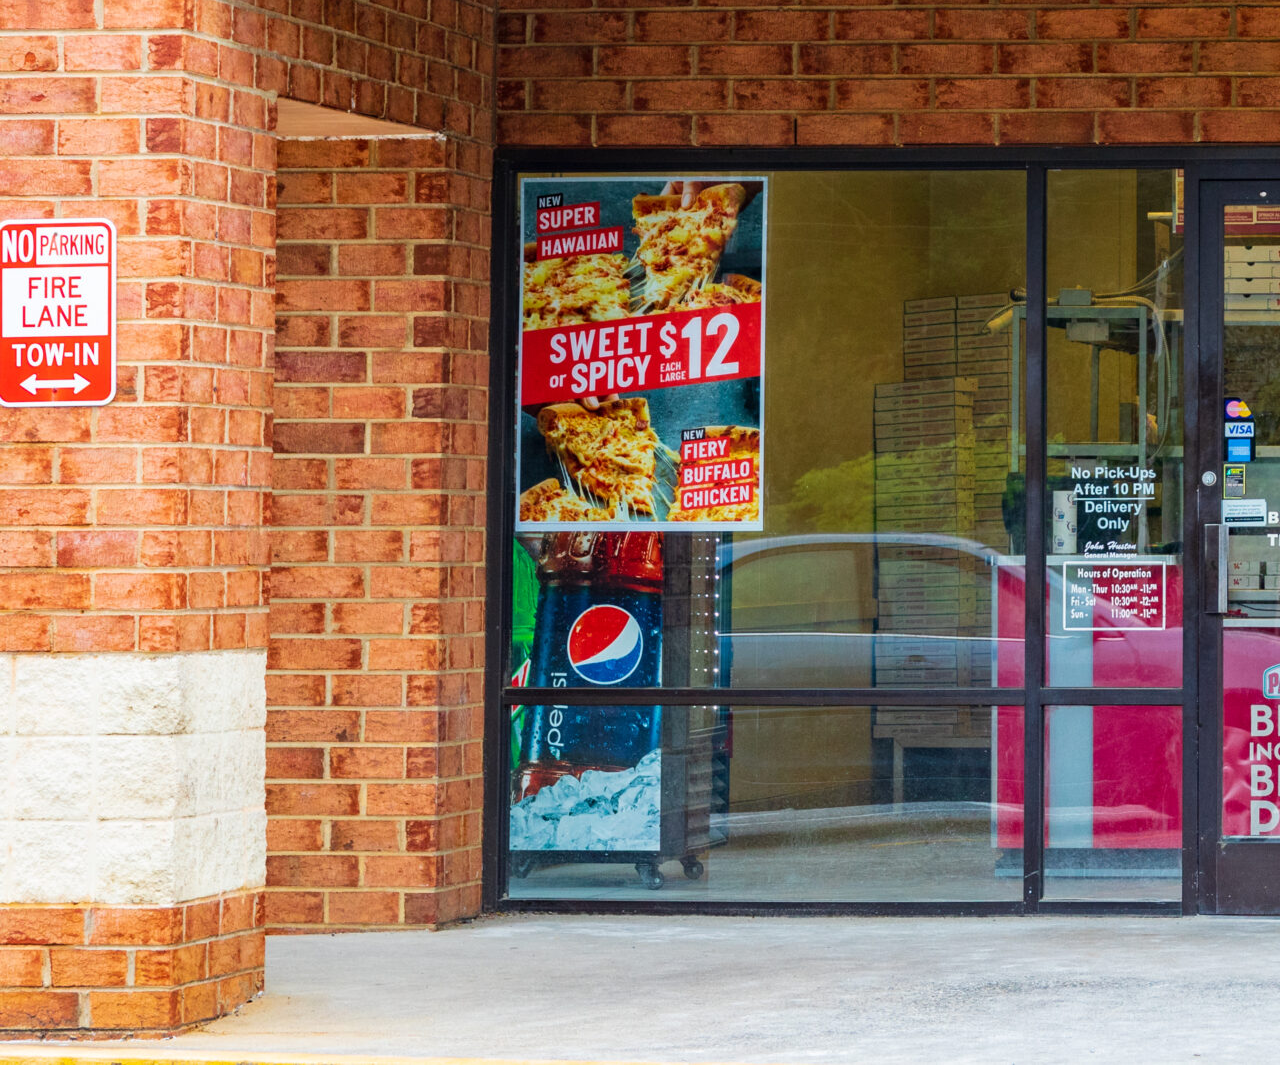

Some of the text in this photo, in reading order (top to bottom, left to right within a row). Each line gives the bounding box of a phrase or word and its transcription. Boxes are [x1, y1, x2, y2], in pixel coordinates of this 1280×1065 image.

[539, 195, 562, 208] NEW
[539, 207, 595, 230] SUPER
[2, 229, 105, 263] NO PARKING
[541, 231, 619, 256] HAWAIIAN
[28, 276, 82, 299] FIRE
[22, 305, 88, 328] LANE
[550, 322, 652, 364] SWEET
[11, 342, 99, 367] TOW-IN
[550, 354, 651, 394] or SPICY
[660, 361, 682, 373] EACH
[660, 371, 687, 382] LARGE
[684, 429, 704, 440] NEW
[1228, 425, 1252, 434] VISA
[684, 440, 728, 461] FIERY
[684, 462, 750, 484] BUFFALO
[1071, 467, 1156, 483] No Pick-Ups
[1073, 483, 1155, 495] After 10 PM
[684, 488, 750, 509] CHICKEN
[1085, 501, 1142, 516] Delivery
[1097, 517, 1130, 532] Only
[1084, 541, 1105, 552] John
[1078, 568, 1152, 580] Hours of Operation
[1071, 584, 1086, 594] Mon
[1092, 584, 1108, 594] Thur
[1071, 596, 1080, 606] Fri
[1085, 596, 1096, 606] Sat
[1071, 609, 1084, 618] Sun
[548, 672, 568, 747] pesi
